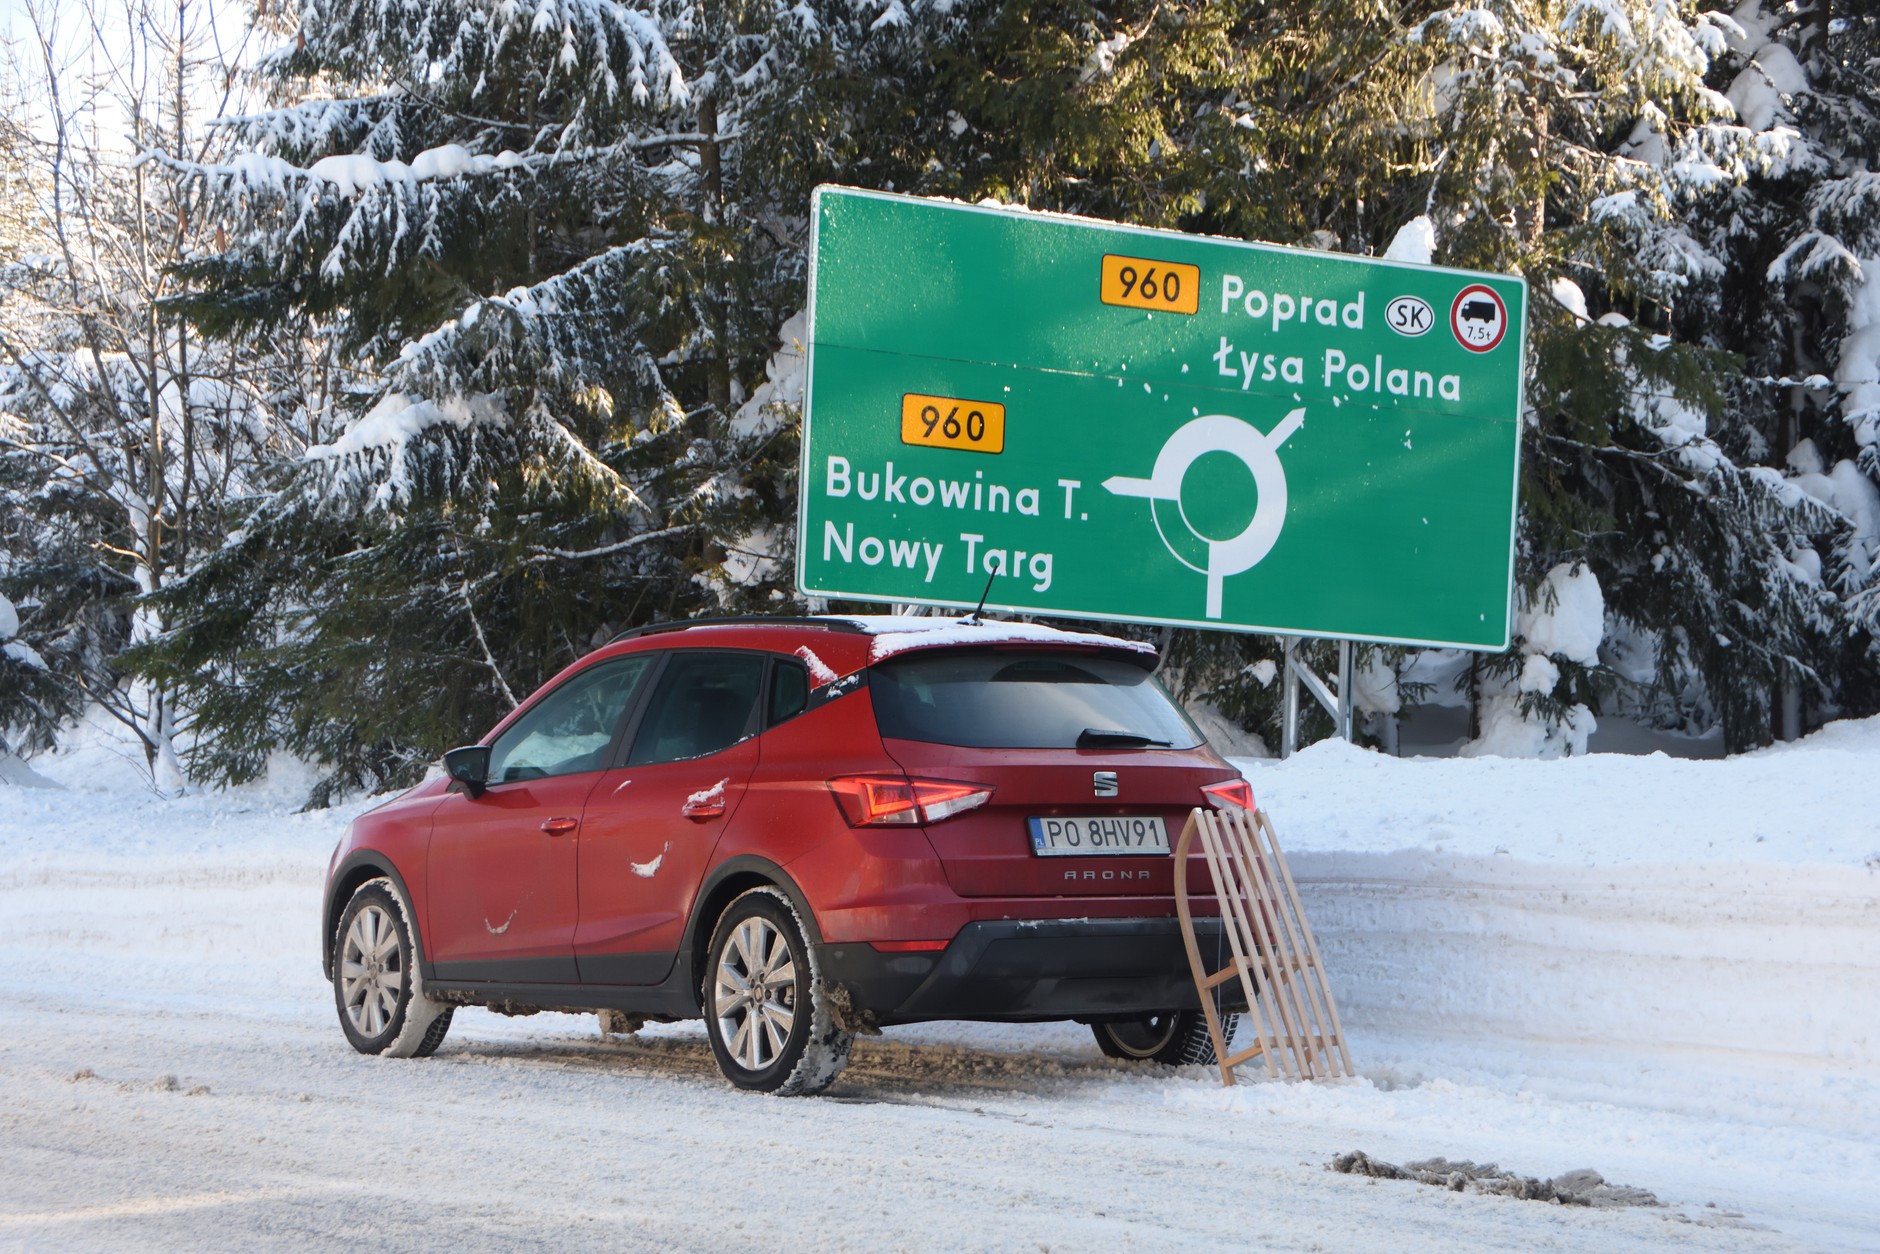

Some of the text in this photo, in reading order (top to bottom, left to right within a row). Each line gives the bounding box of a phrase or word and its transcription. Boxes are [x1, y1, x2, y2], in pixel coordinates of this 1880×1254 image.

[1119, 266, 1180, 302] 960
[1221, 274, 1366, 332] Poprad
[1395, 304, 1425, 329] SK
[1213, 336, 1461, 401] Łysa Polana
[921, 405, 985, 442] 960
[826, 455, 1088, 521] Bukowina T.
[823, 520, 1053, 592] Nowy Targ
[1046, 820, 1160, 847] PO 8HV91
[1064, 870, 1150, 880] ARONA
